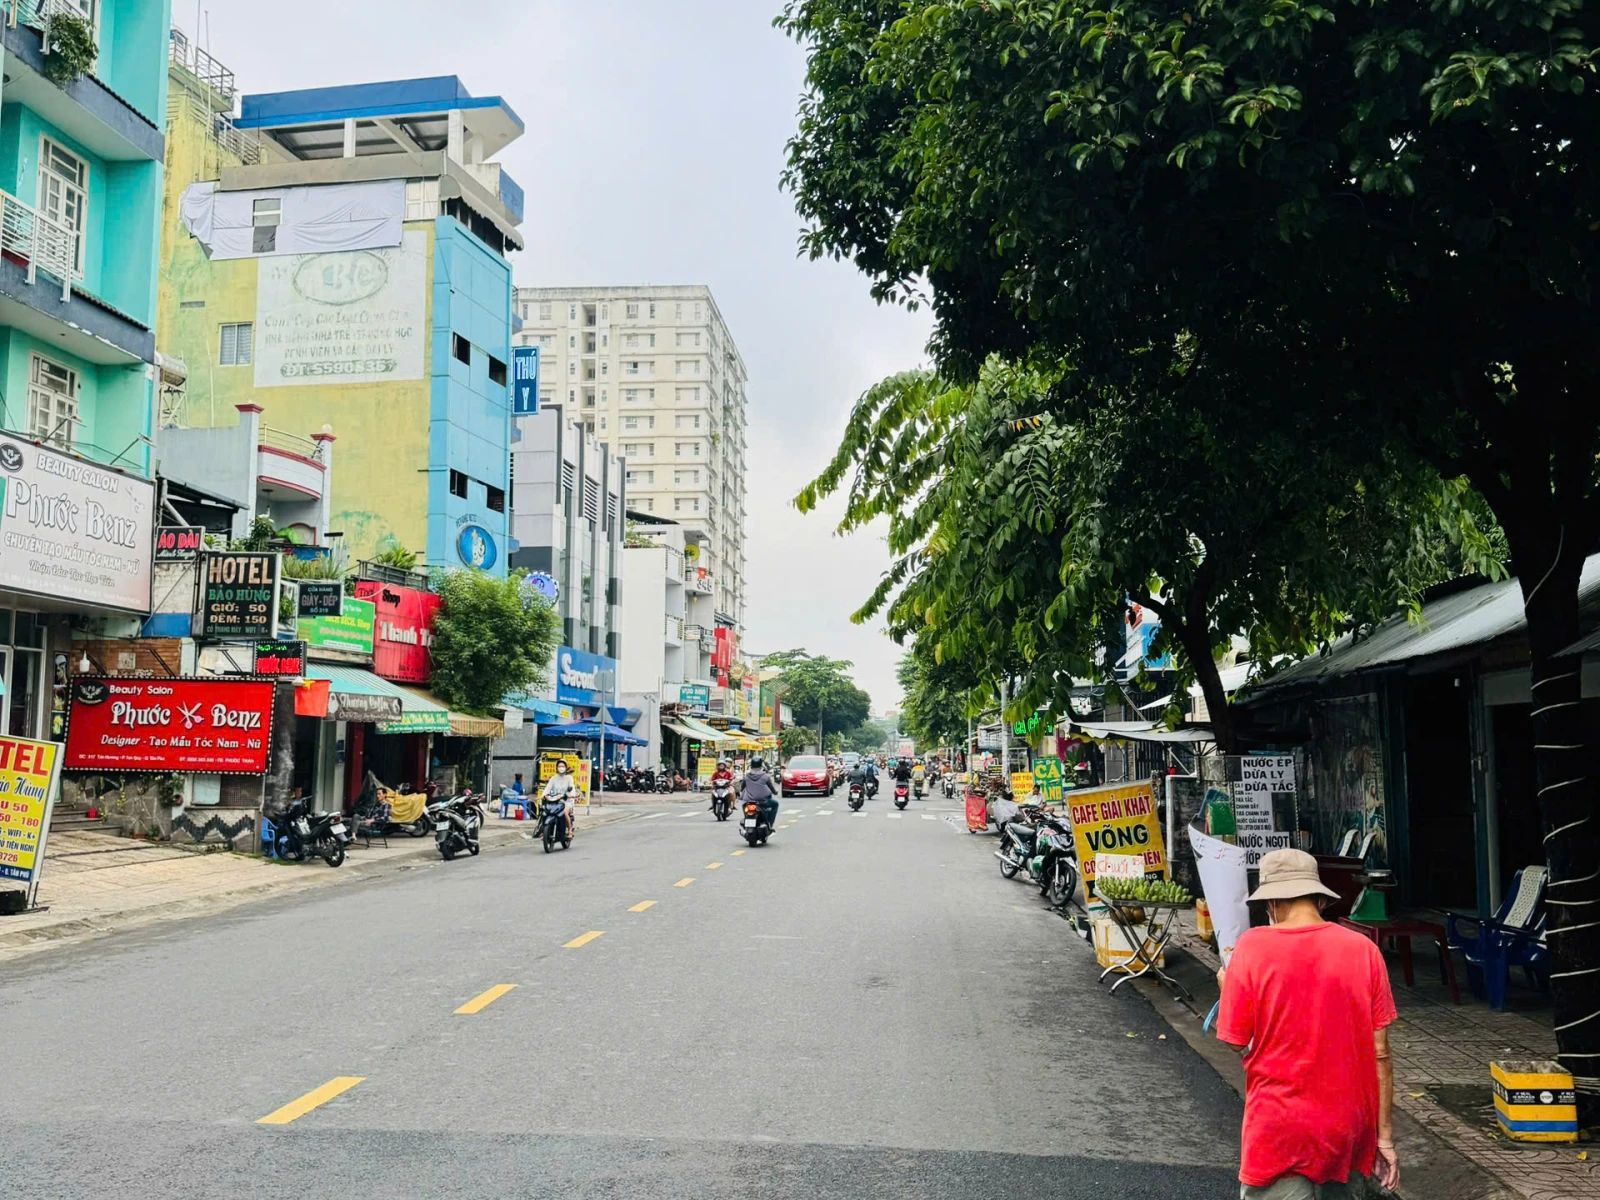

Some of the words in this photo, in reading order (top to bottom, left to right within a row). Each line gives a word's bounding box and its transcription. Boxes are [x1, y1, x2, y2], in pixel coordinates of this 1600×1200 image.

[516, 352, 537, 380] THÚ
[522, 387, 530, 410] Y
[37, 454, 81, 481] BEAUTY
[81, 469, 119, 493] SALON
[6, 475, 80, 533] Phước
[86, 497, 137, 548] Benz
[158, 529, 176, 549] ÁO
[177, 529, 199, 549] DÀI
[4, 531, 43, 554] CHUYÊN
[102, 554, 122, 571] NAM
[209, 557, 273, 584] HOTEL
[209, 585, 234, 601] BẢO
[236, 587, 271, 601] HÙNG
[211, 602, 240, 612] GIỜ:
[249, 604, 267, 612] 50
[210, 614, 241, 624] ĐÊM:
[245, 615, 267, 624] 150
[561, 653, 614, 693] Sacom
[110, 685, 142, 696] Beauty
[147, 685, 173, 695] Salon
[111, 701, 171, 729] Phước
[211, 703, 261, 731] Benz
[101, 735, 140, 747] Designer
[149, 736, 167, 749] Tạo
[194, 737, 213, 747] Tóc
[217, 738, 239, 748] Nam
[247, 738, 261, 749] Nữ
[0, 740, 48, 777] TEL
[1243, 757, 1274, 768] NƯỚC
[1277, 756, 1292, 767] ÉP
[1243, 768, 1267, 779] DỪA
[1271, 770, 1284, 779] LY
[0, 776, 10, 792] ảo
[14, 776, 46, 802] Hùng
[1245, 781, 1268, 791] DỪA
[1271, 780, 1294, 791] TẮC
[13, 802, 28, 813] 50
[1072, 803, 1100, 825] CAFE
[1100, 795, 1123, 821] GIẢI
[1123, 793, 1152, 817] KHÁT
[0, 813, 11, 823] 50
[21, 816, 39, 828] 180
[7, 828, 22, 839] WIFI
[26, 830, 36, 840] K+
[1085, 824, 1150, 852] VÕNG
[1238, 833, 1263, 848] NƯỚC
[1266, 836, 1288, 849] NGỌT
[19, 843, 34, 853] NGHI
